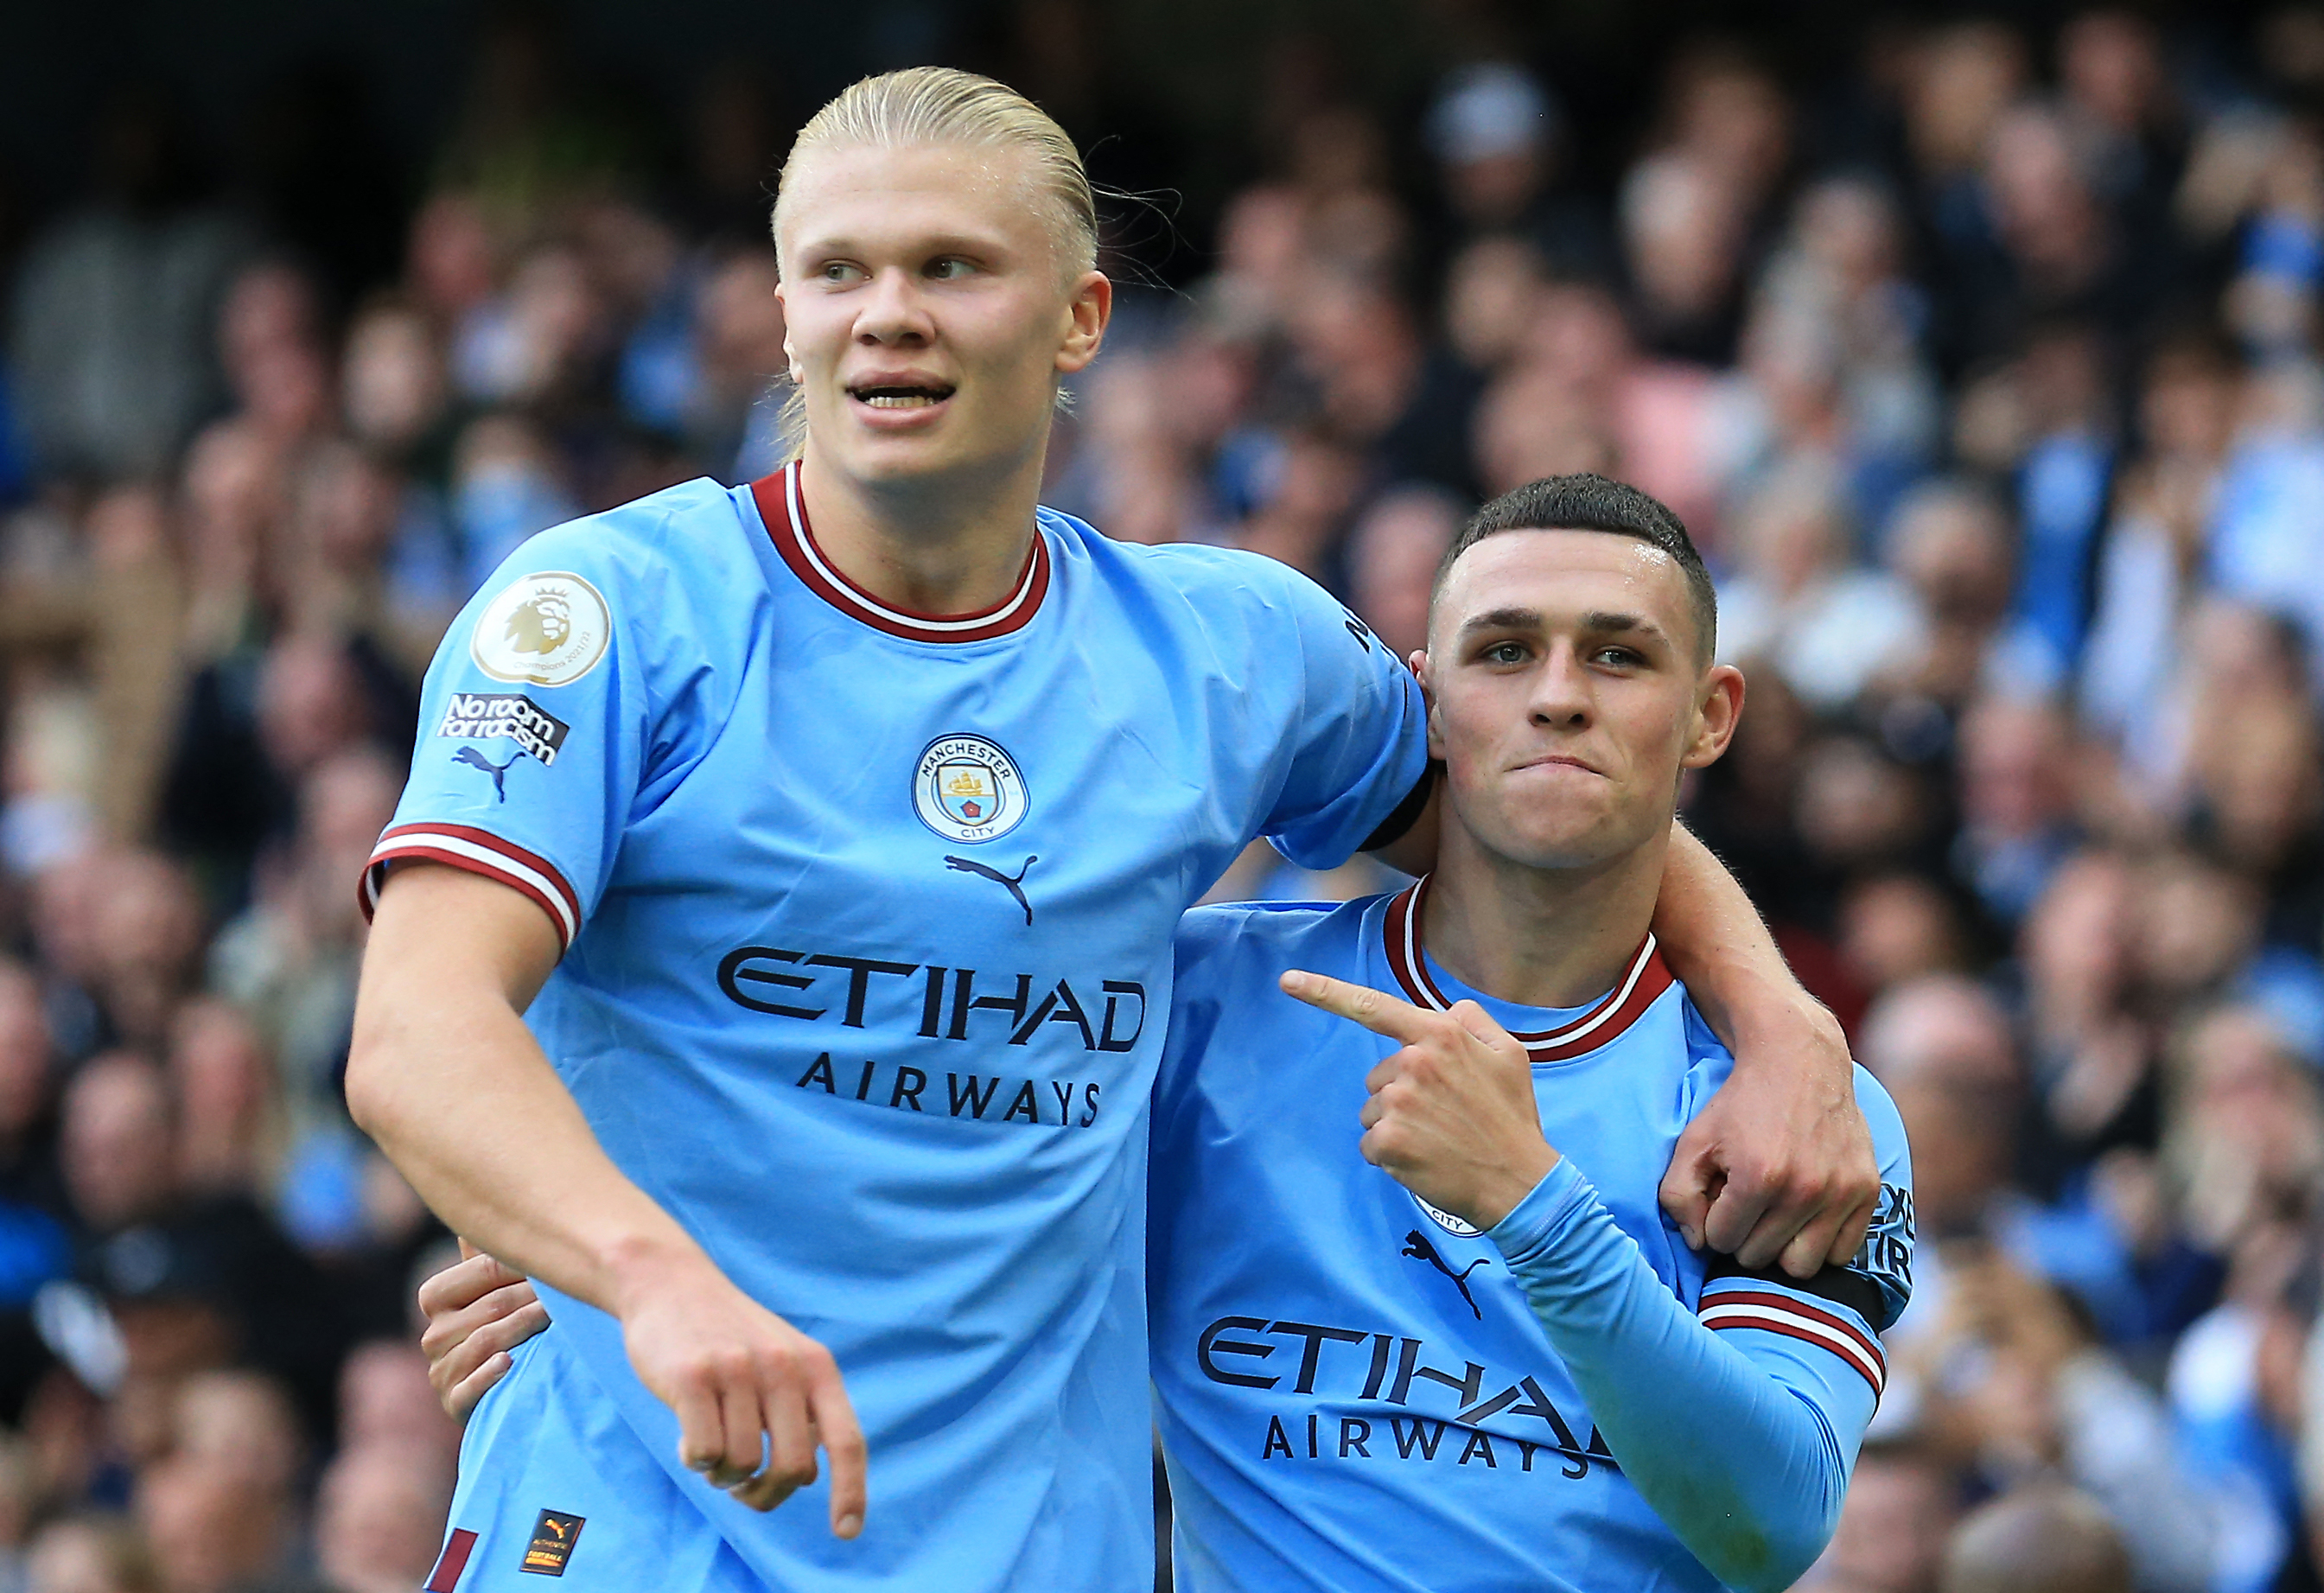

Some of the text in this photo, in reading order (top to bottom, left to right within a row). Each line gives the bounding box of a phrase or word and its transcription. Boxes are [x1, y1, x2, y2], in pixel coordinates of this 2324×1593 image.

[436, 717, 557, 768] for racism
[445, 694, 556, 742] No room
[921, 743, 1011, 780] MANCHESTER
[961, 826, 995, 838] CITY
[716, 946, 1146, 1052] ETIHAD
[796, 1052, 1100, 1128] AIRWAYS
[1432, 1210, 1462, 1229] CITY
[1263, 1414, 1589, 1480] AIRWAYS
